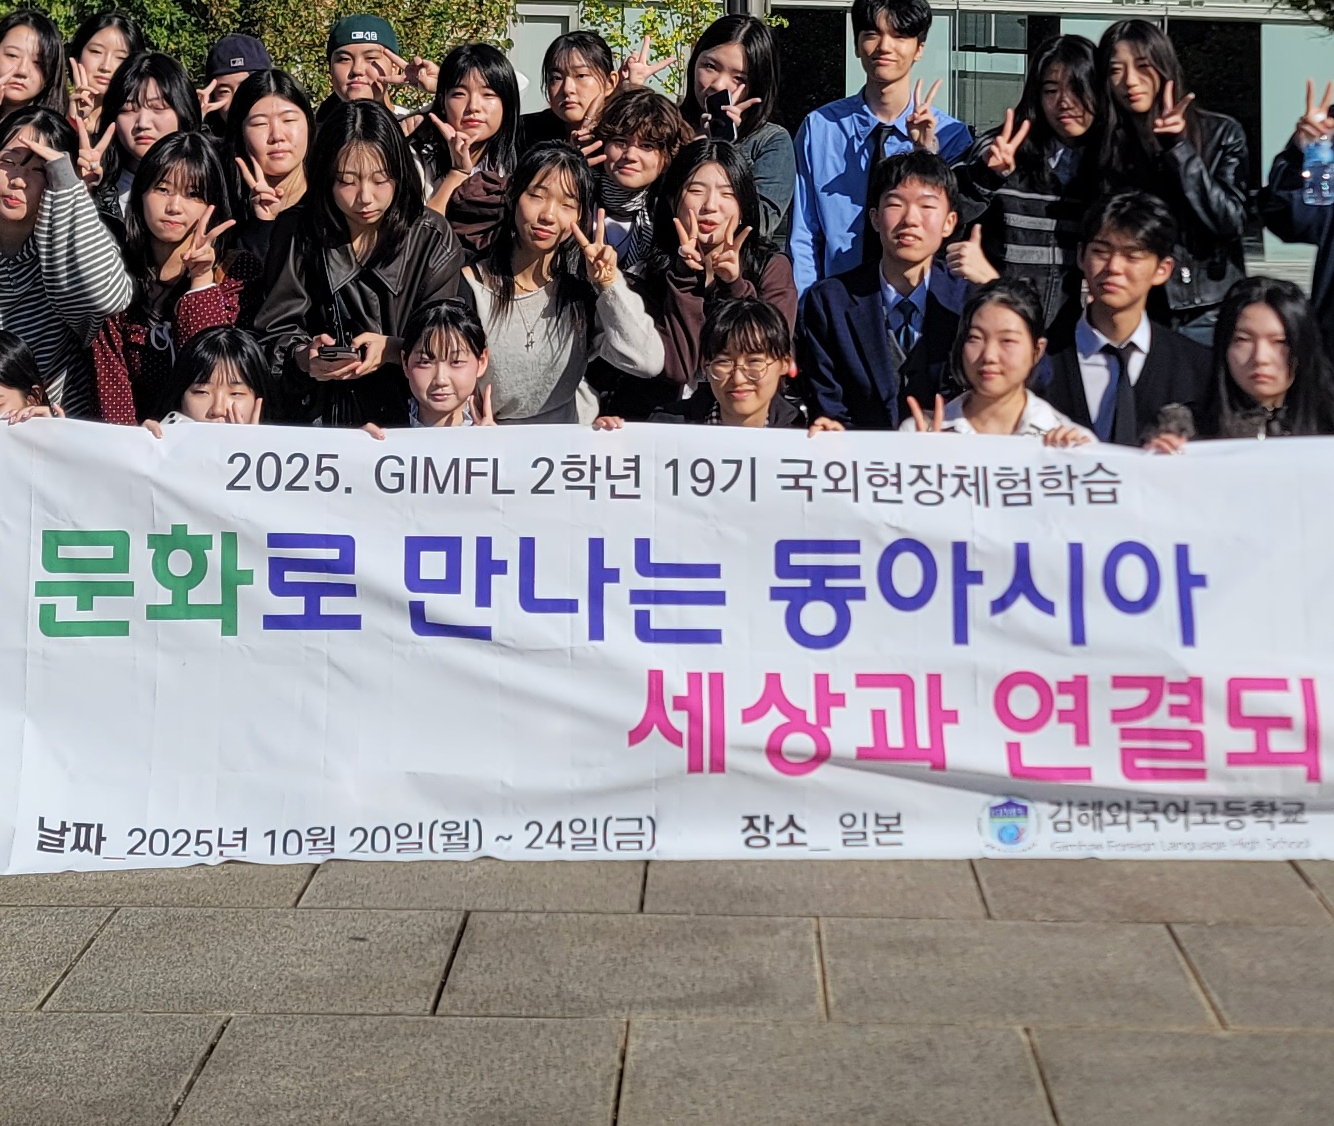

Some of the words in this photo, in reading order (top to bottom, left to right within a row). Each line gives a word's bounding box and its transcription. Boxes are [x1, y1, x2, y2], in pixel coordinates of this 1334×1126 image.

[225, 451, 353, 494] 2025.
[373, 454, 516, 495] GIMFL
[530, 454, 642, 500] 2학년
[664, 456, 757, 502] 19기
[775, 457, 1123, 509] 국외현장체험학습
[34, 523, 362, 637] 문화로
[403, 534, 727, 645] 만나는
[768, 536, 1208, 651] 동아시아
[627, 668, 959, 778] 세상과
[263, 825, 336, 856] 10월
[348, 818, 484, 854] 20일(월)
[524, 815, 657, 852] 24일(금)
[839, 812, 904, 847] 일본
[1048, 800, 1309, 833] 김해외국어고등학교
